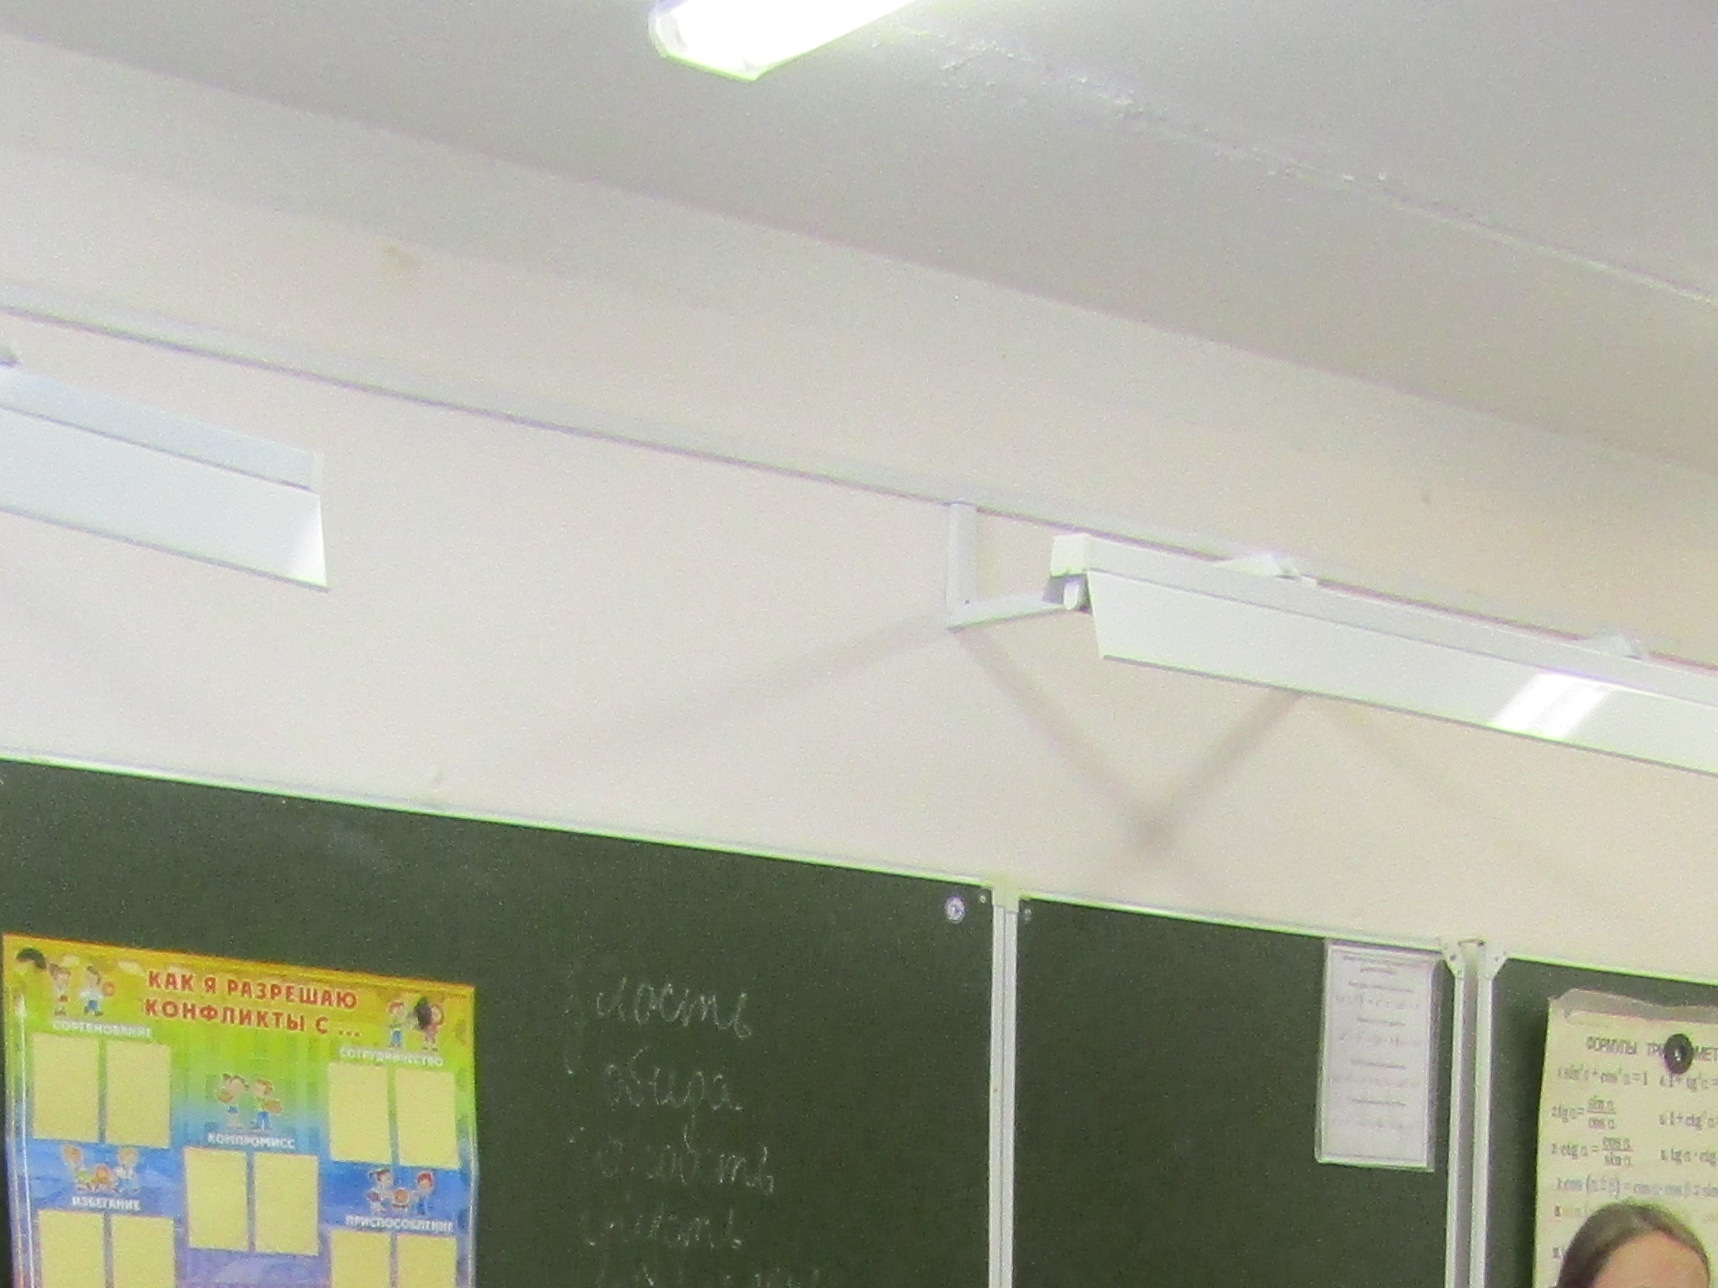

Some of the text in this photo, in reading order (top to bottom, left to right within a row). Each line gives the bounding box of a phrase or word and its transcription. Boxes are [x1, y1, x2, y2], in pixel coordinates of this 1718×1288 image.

[148, 970, 358, 1010] КАК Я РАЗРЕШАЮ
[144, 998, 306, 1033] КОНФЛИКТЫ
[315, 1016, 329, 1035] С
[1586, 1036, 1638, 1055] ФОРМУЛЫ
[207, 1132, 296, 1150] КОМПРОМИСС
